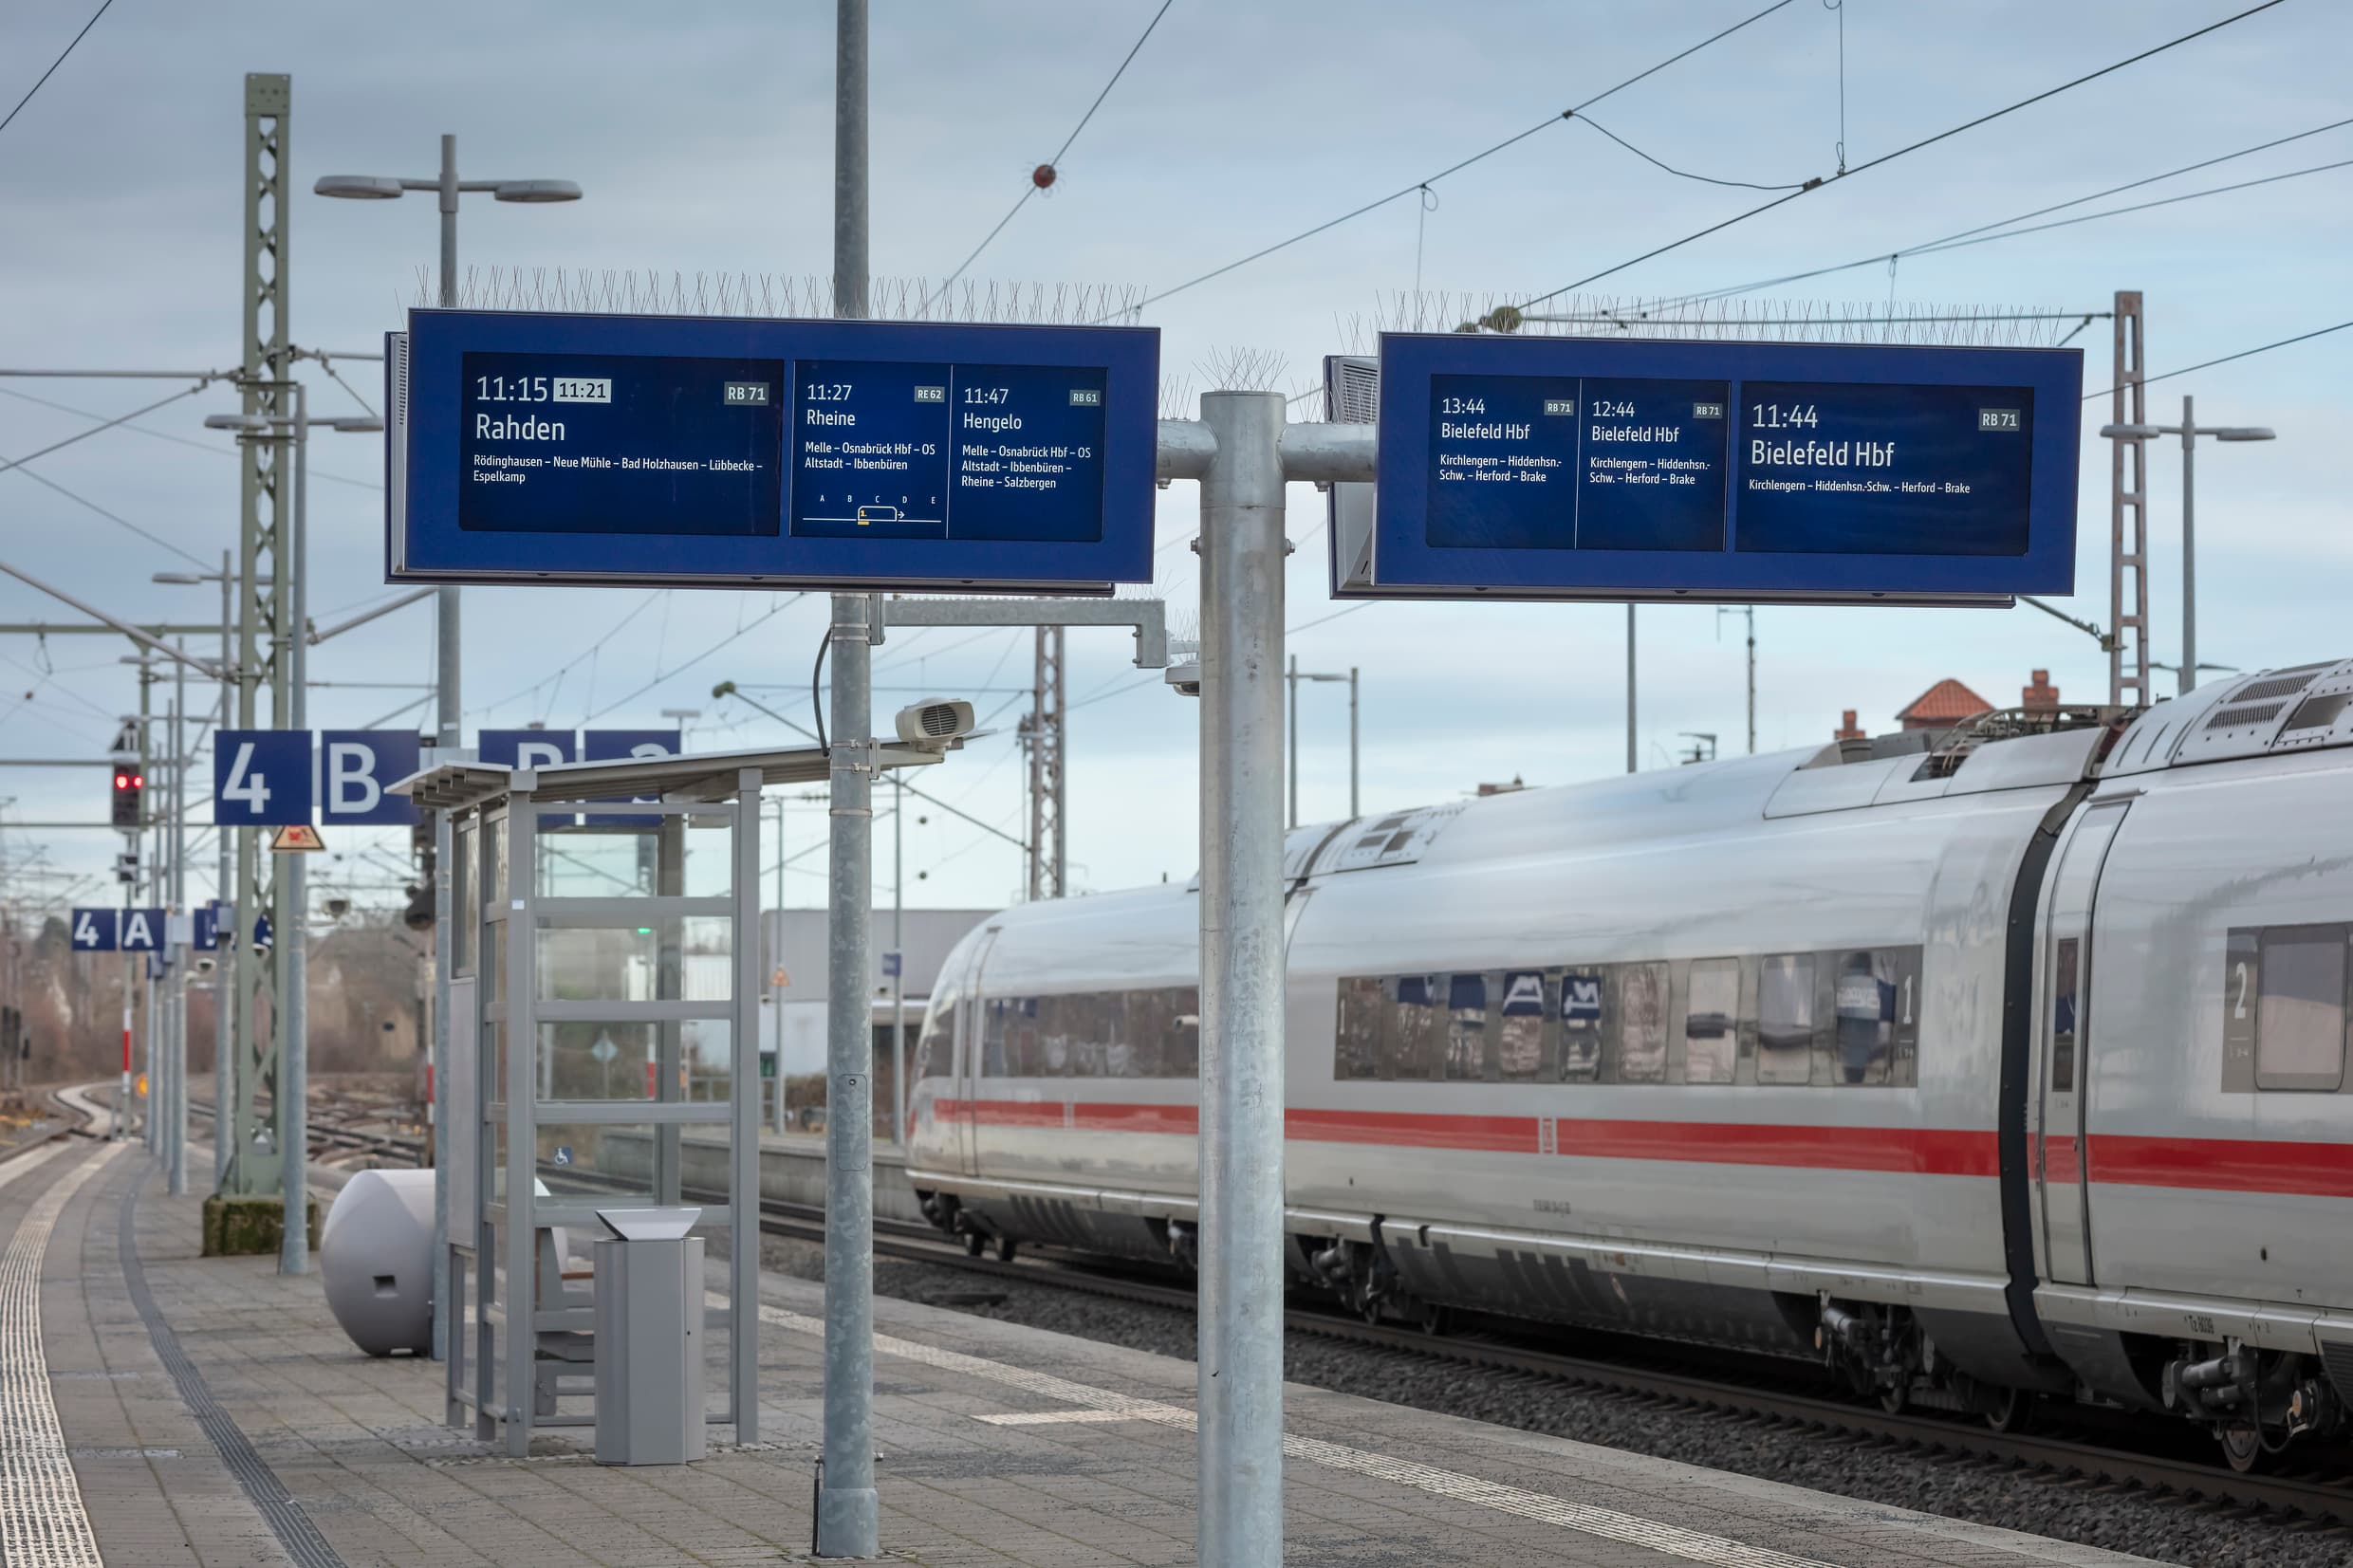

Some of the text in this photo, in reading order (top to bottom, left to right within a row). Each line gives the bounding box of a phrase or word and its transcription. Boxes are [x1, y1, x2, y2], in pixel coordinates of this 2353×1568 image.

[477, 376, 547, 401] 11:15
[558, 380, 608, 400] 11:21
[729, 387, 766, 400] RB 71
[807, 384, 852, 400] 11:27
[917, 390, 941, 399] RE 62
[965, 388, 1009, 404] 11:47
[1073, 393, 1097, 402] RB 61
[1443, 397, 1485, 414] 13:44
[1547, 403, 1570, 413] RB 71
[1593, 401, 1635, 417] 12:44
[1696, 406, 1719, 415] RB 71
[1753, 404, 1818, 428] 11:44
[807, 409, 855, 426] Rheine
[964, 413, 1022, 433] Hengelo
[1983, 414, 2016, 426] RB 71
[476, 414, 565, 440] Rahden
[1442, 422, 1530, 439] Bielefeld Hbf
[1592, 426, 1679, 442] Bielefeld Hbf
[806, 441, 832, 452] Melle
[843, 442, 892, 454] Osnabrück
[895, 443, 912, 454] Hbf
[922, 444, 936, 455] OS
[963, 445, 989, 456] Melle
[999, 445, 1048, 457] Osnabrück
[1050, 447, 1067, 457] Hbf
[1078, 447, 1091, 458] OS
[1752, 440, 1895, 467] Bielefeld Hbf
[474, 454, 543, 469] Rödinghausen
[553, 456, 579, 468] Neue
[581, 456, 611, 468] Mühle
[622, 457, 640, 469] Bad
[642, 458, 698, 470] Holzhausen
[710, 459, 754, 470] Lübbecke
[805, 457, 843, 469] Altstadt
[854, 458, 907, 470] Ibbenbüren
[962, 460, 999, 471] Altstadt
[1010, 461, 1064, 472] Ibbenbüren
[1440, 454, 1498, 469] Kirchlengern
[1509, 455, 1562, 467] Hiddenhsn.-
[1590, 457, 1647, 470] Kirchlengern
[1658, 458, 1711, 470] Hiddenhsn.-
[473, 470, 526, 485] Espelkamp
[962, 475, 994, 487] Rheine
[1005, 476, 1056, 490] Salzbergen
[1439, 470, 1465, 480] Schw.
[1475, 470, 1510, 481] Herford
[1521, 470, 1547, 482] Brake
[1590, 471, 1615, 483] Schw.
[1625, 472, 1659, 484] Herford
[1670, 473, 1695, 485] Brake
[1750, 479, 1806, 492] Kirchlengern
[1815, 480, 1892, 491] Hiddenhsn.-Schw.
[1901, 482, 1936, 492] Herford
[1945, 482, 1970, 493] Brake
[222, 743, 380, 813] 4 B
[74, 912, 153, 947] 4 A
[2234, 962, 2247, 1019] 2
[1903, 975, 1912, 1024] 1
